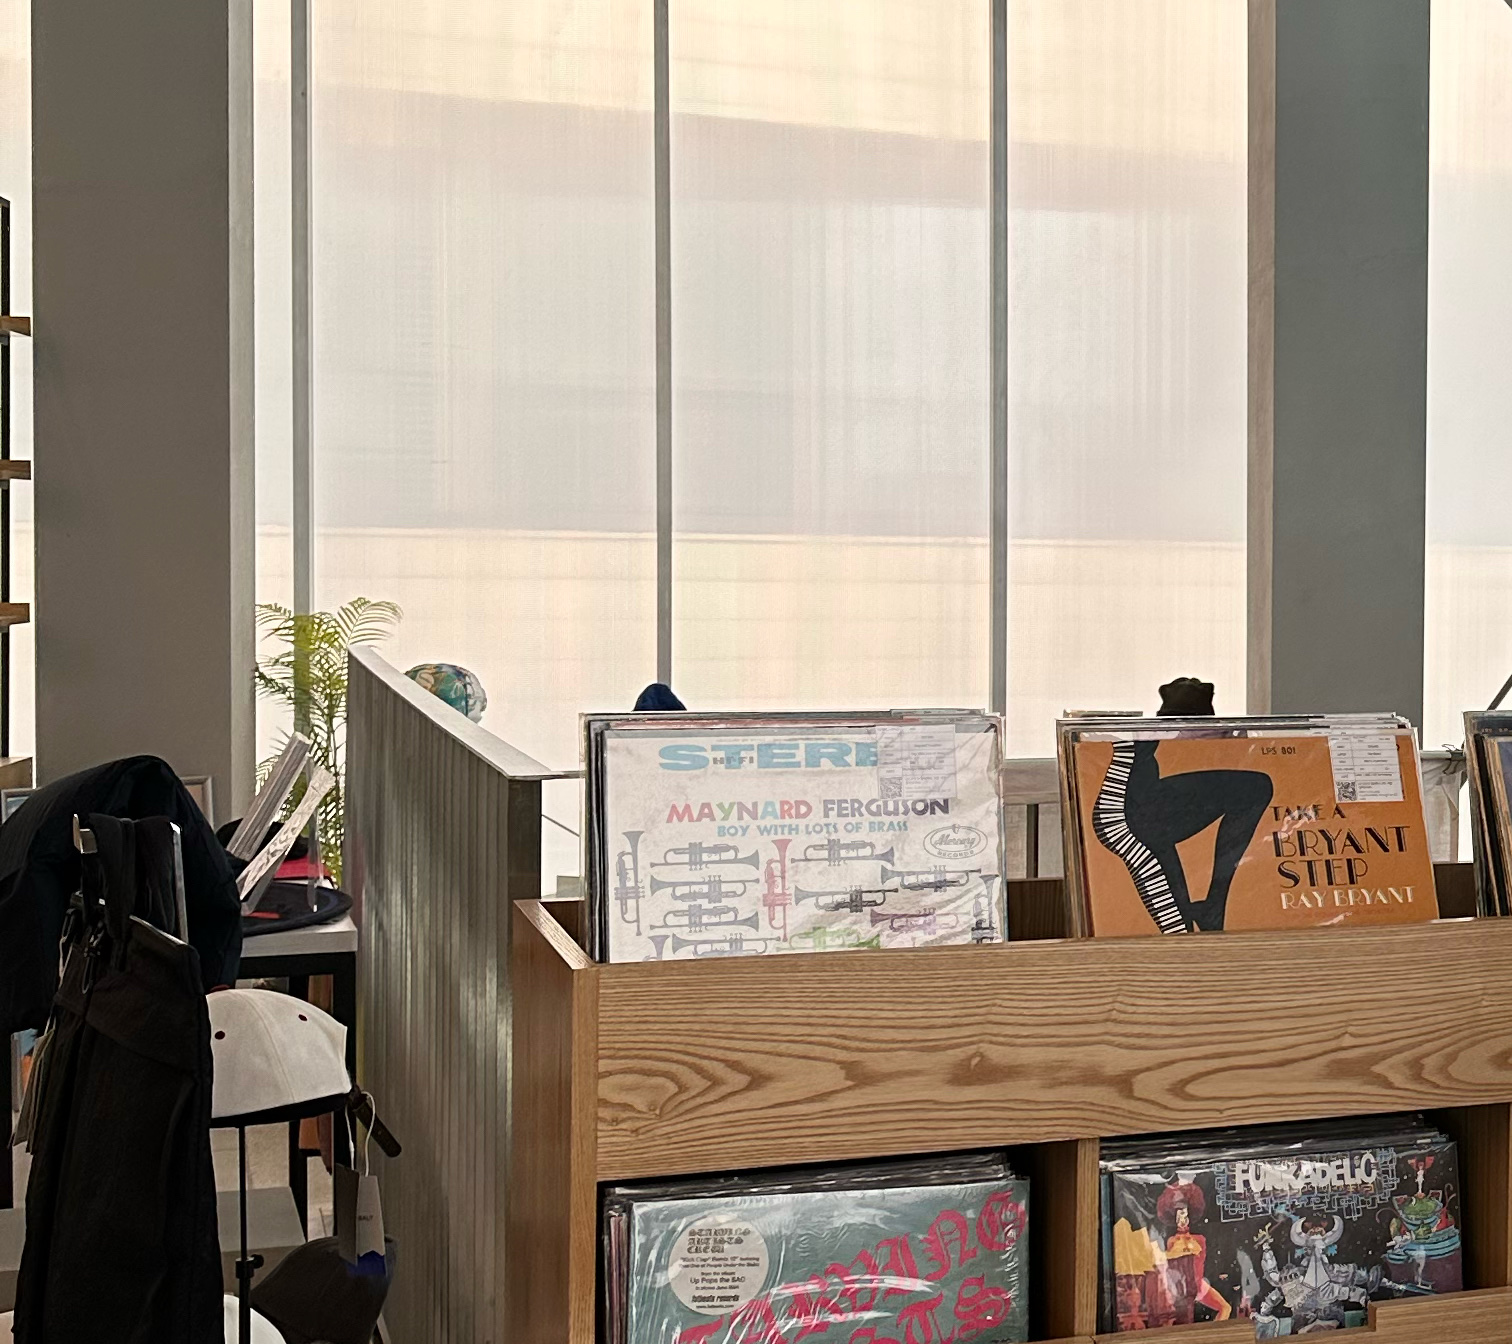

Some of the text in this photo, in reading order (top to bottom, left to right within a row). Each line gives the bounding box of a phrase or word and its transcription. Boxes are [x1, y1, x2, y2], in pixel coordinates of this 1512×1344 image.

[659, 743, 878, 771] STERE
[1261, 746, 1297, 755] LPS 801
[666, 799, 950, 824] MAYNARD FERGUSON
[1270, 803, 1347, 822] TAKE A
[717, 820, 909, 837] BOY WITH LOTS OF BRASS
[1272, 826, 1411, 858] BRYANT
[1277, 858, 1369, 889] STEP
[1280, 885, 1416, 910] RAY BRYANT
[1234, 1150, 1378, 1193] FUNKADELIC
